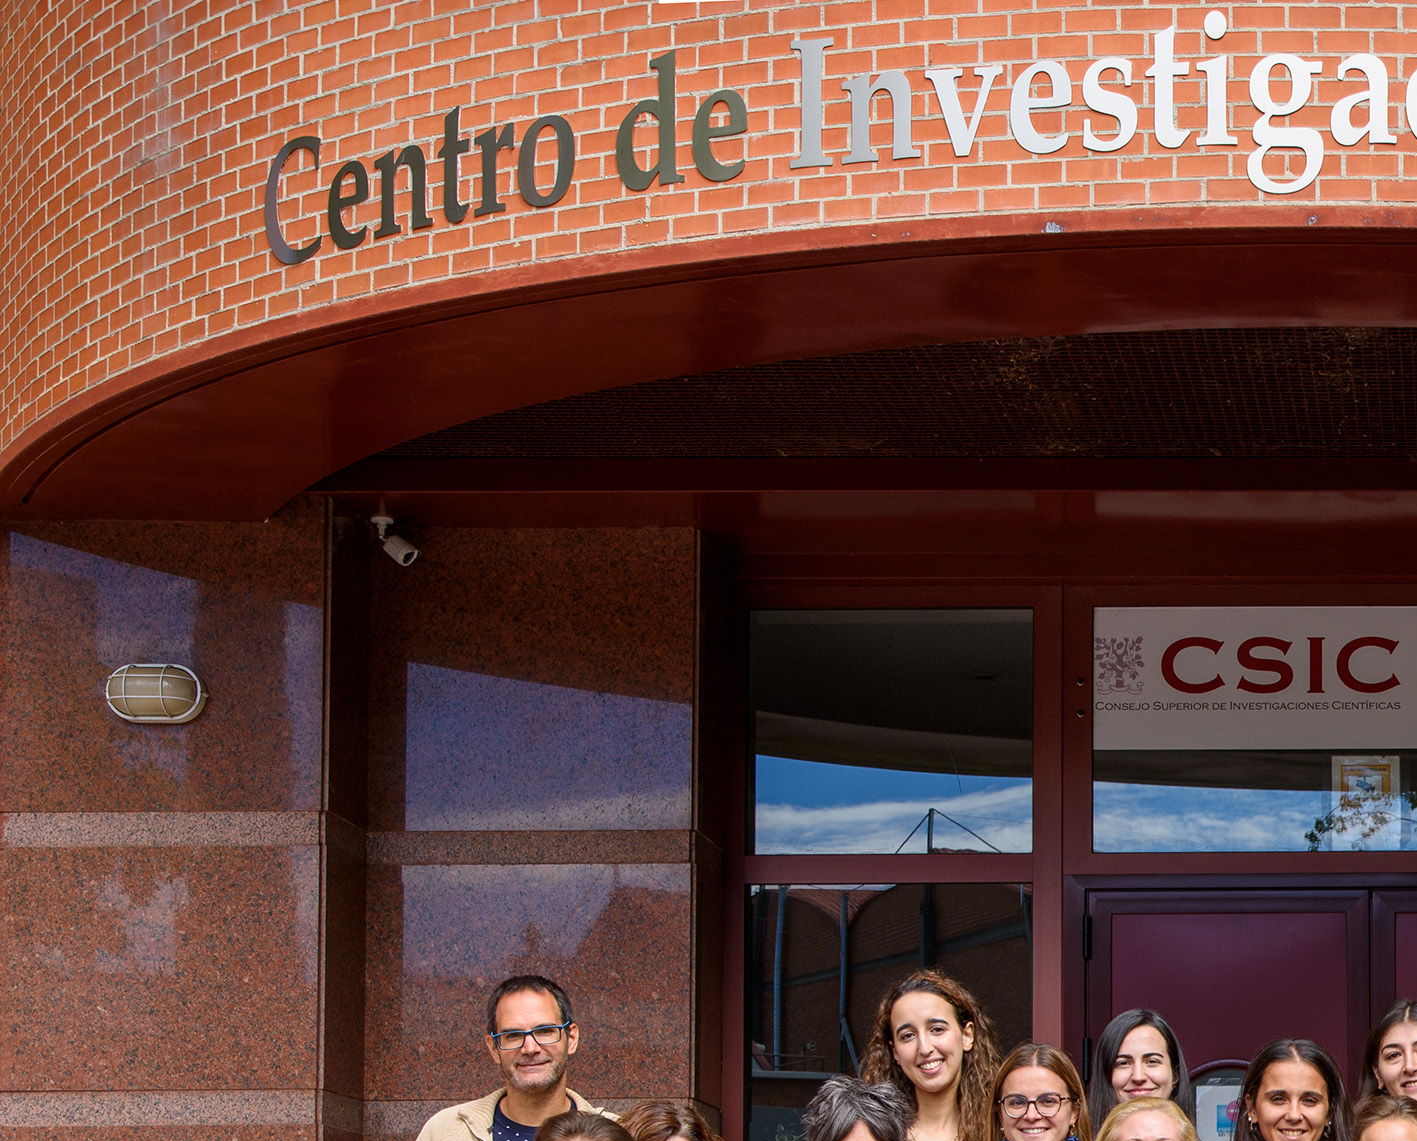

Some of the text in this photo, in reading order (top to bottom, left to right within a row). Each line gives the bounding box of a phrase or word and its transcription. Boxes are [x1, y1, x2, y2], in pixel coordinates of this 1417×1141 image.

[264, 105, 576, 265] Centro
[616, 50, 749, 192] de
[1161, 636, 1402, 694] CSIC
[1095, 701, 1150, 711] CONSEJO
[1152, 701, 1209, 711] SUPERIOR
[1230, 701, 1329, 711] INVESTIGACIONES
